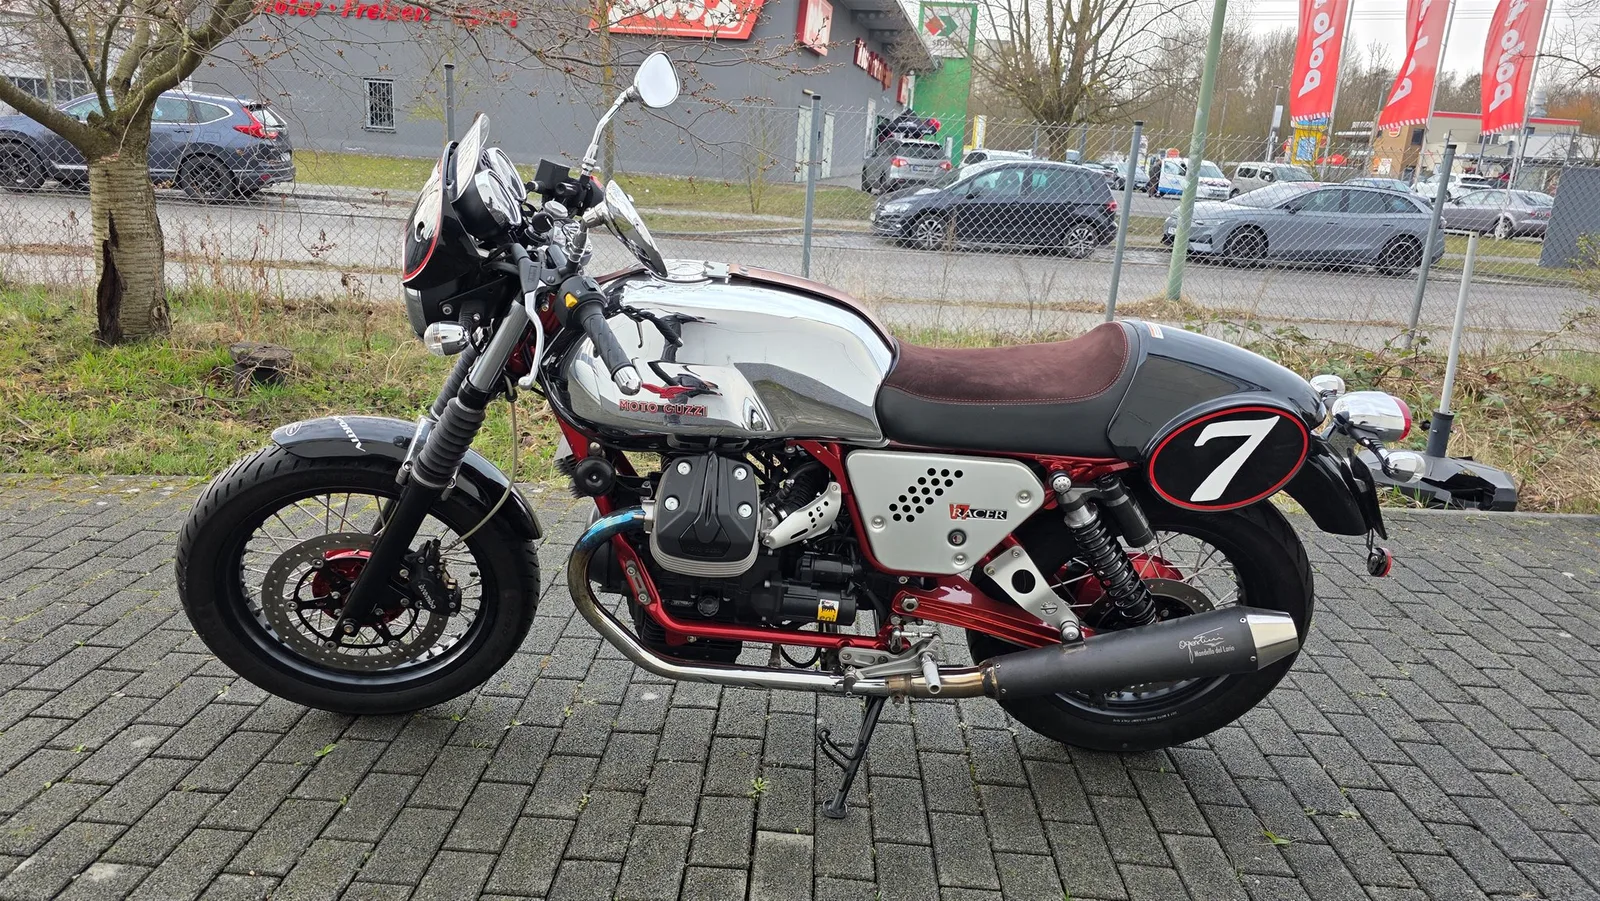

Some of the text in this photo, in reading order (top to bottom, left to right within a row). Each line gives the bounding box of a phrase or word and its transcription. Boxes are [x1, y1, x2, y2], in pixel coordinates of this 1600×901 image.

[619, 399, 708, 417] MOTO GUZZI
[1190, 415, 1281, 502] 7
[951, 507, 1007, 520] RACER
[418, 583, 437, 609] brembo
